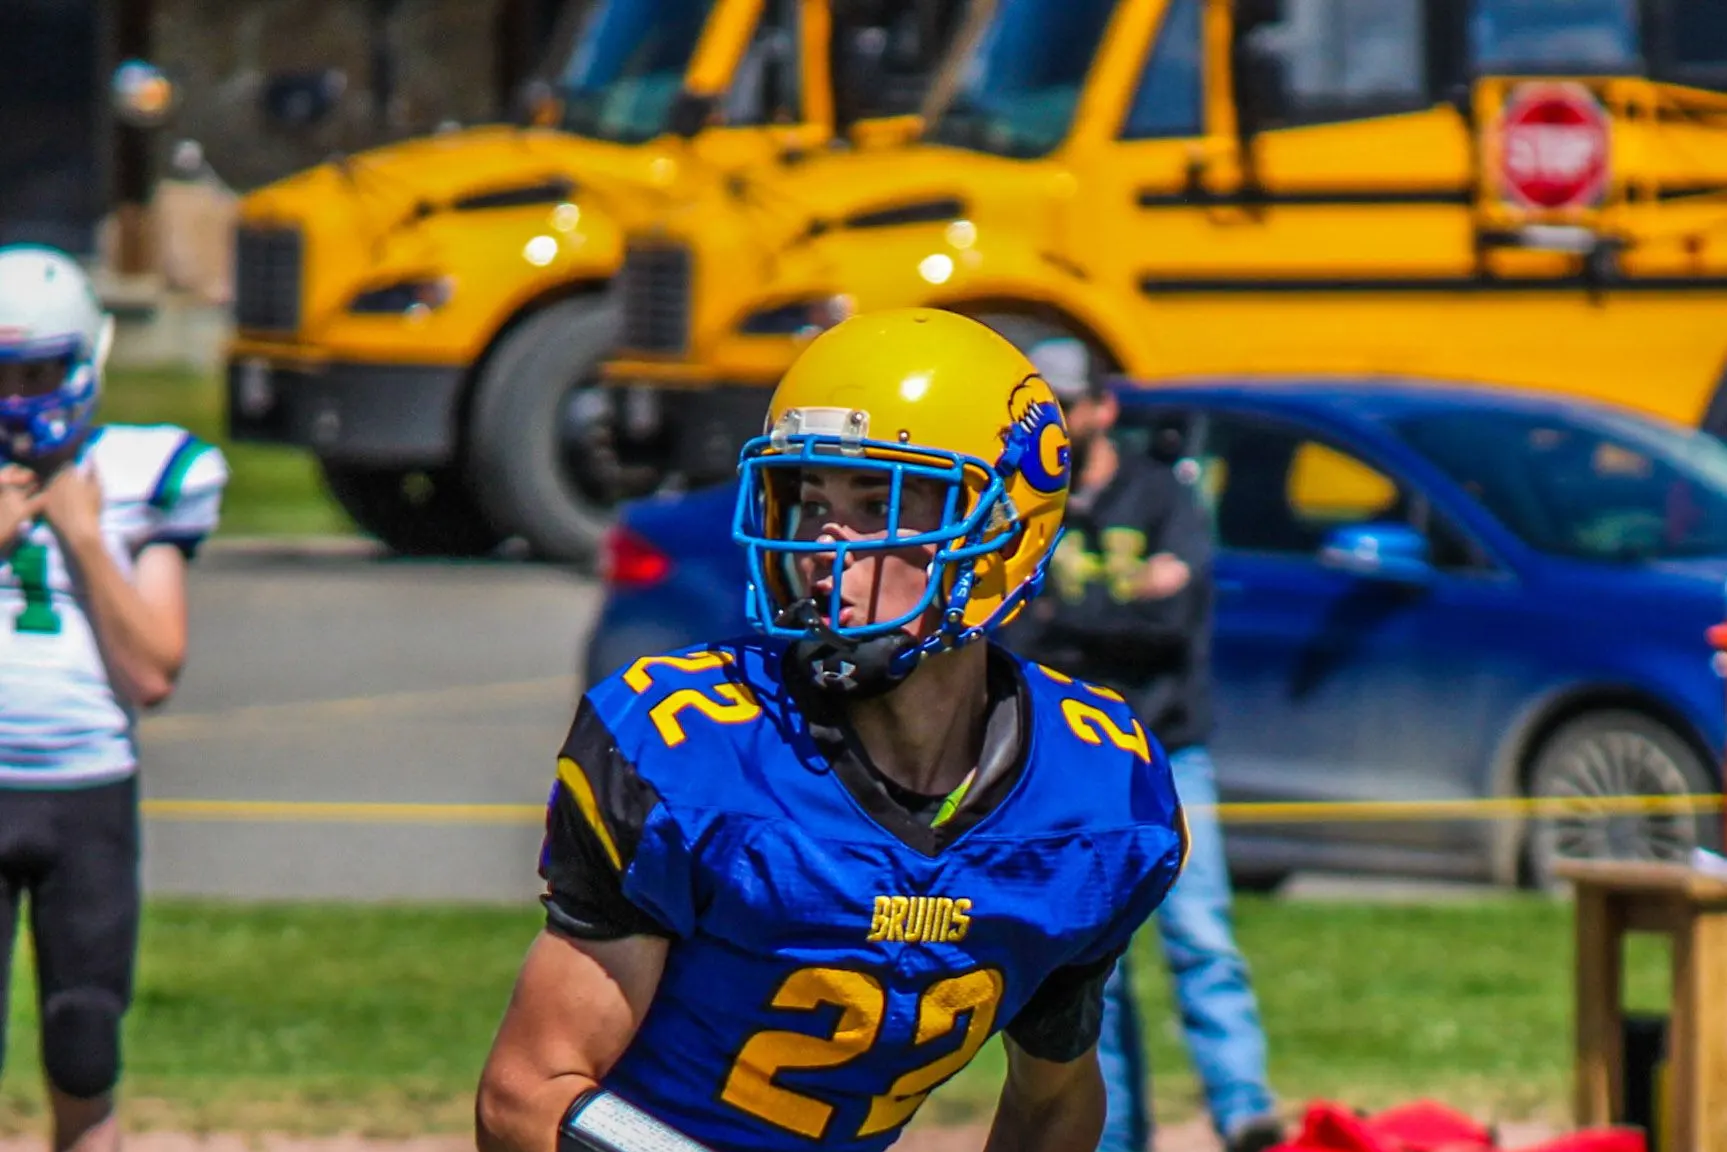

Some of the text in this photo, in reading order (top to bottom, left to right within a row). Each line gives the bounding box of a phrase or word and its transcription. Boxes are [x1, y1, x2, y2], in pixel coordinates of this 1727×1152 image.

[1506, 127, 1597, 176] STOP
[622, 650, 762, 748] 22
[866, 895, 972, 942] BRUINS
[720, 967, 1004, 1139] 22
